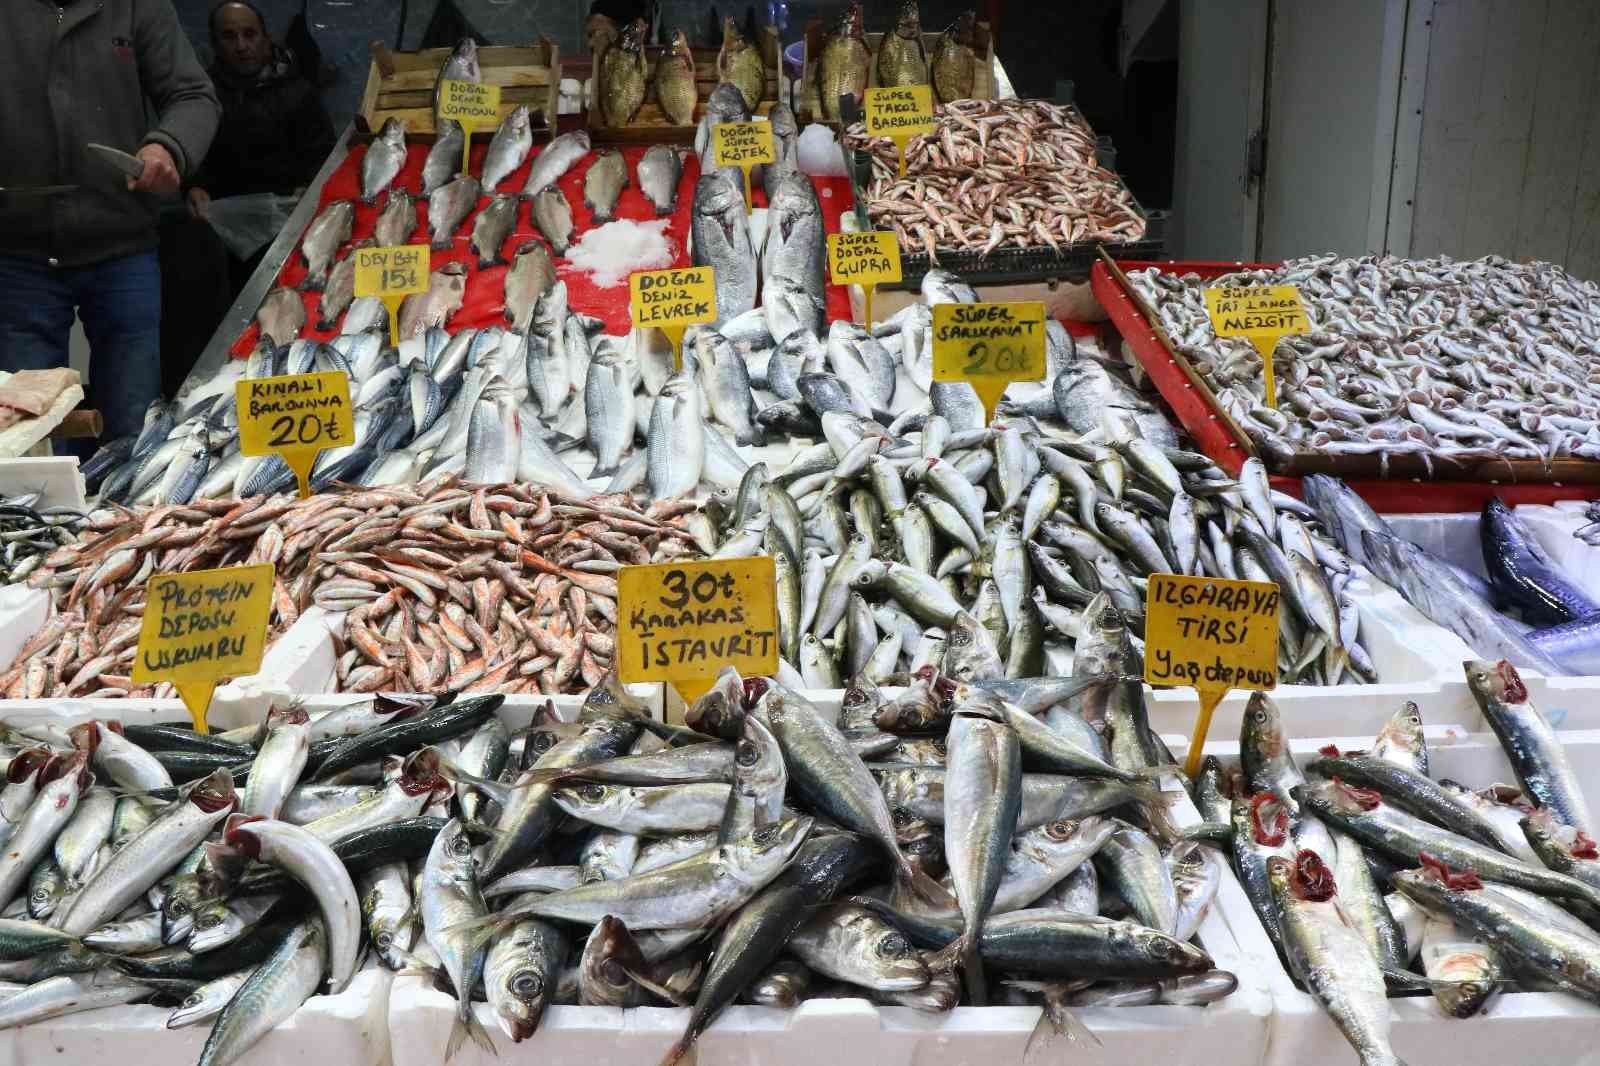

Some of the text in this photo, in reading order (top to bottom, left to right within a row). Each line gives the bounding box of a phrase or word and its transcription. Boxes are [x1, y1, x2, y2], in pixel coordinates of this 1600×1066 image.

[720, 145, 770, 162] KÖTEK
[837, 233, 879, 246] SÜPER
[836, 245, 884, 258] DOĞAL
[639, 271, 705, 291] DOĞAL
[1221, 287, 1273, 298] SÜPER
[639, 302, 709, 323] LEVREK
[950, 305, 1015, 323] SÜPER
[158, 609, 236, 638] DEPOSU
